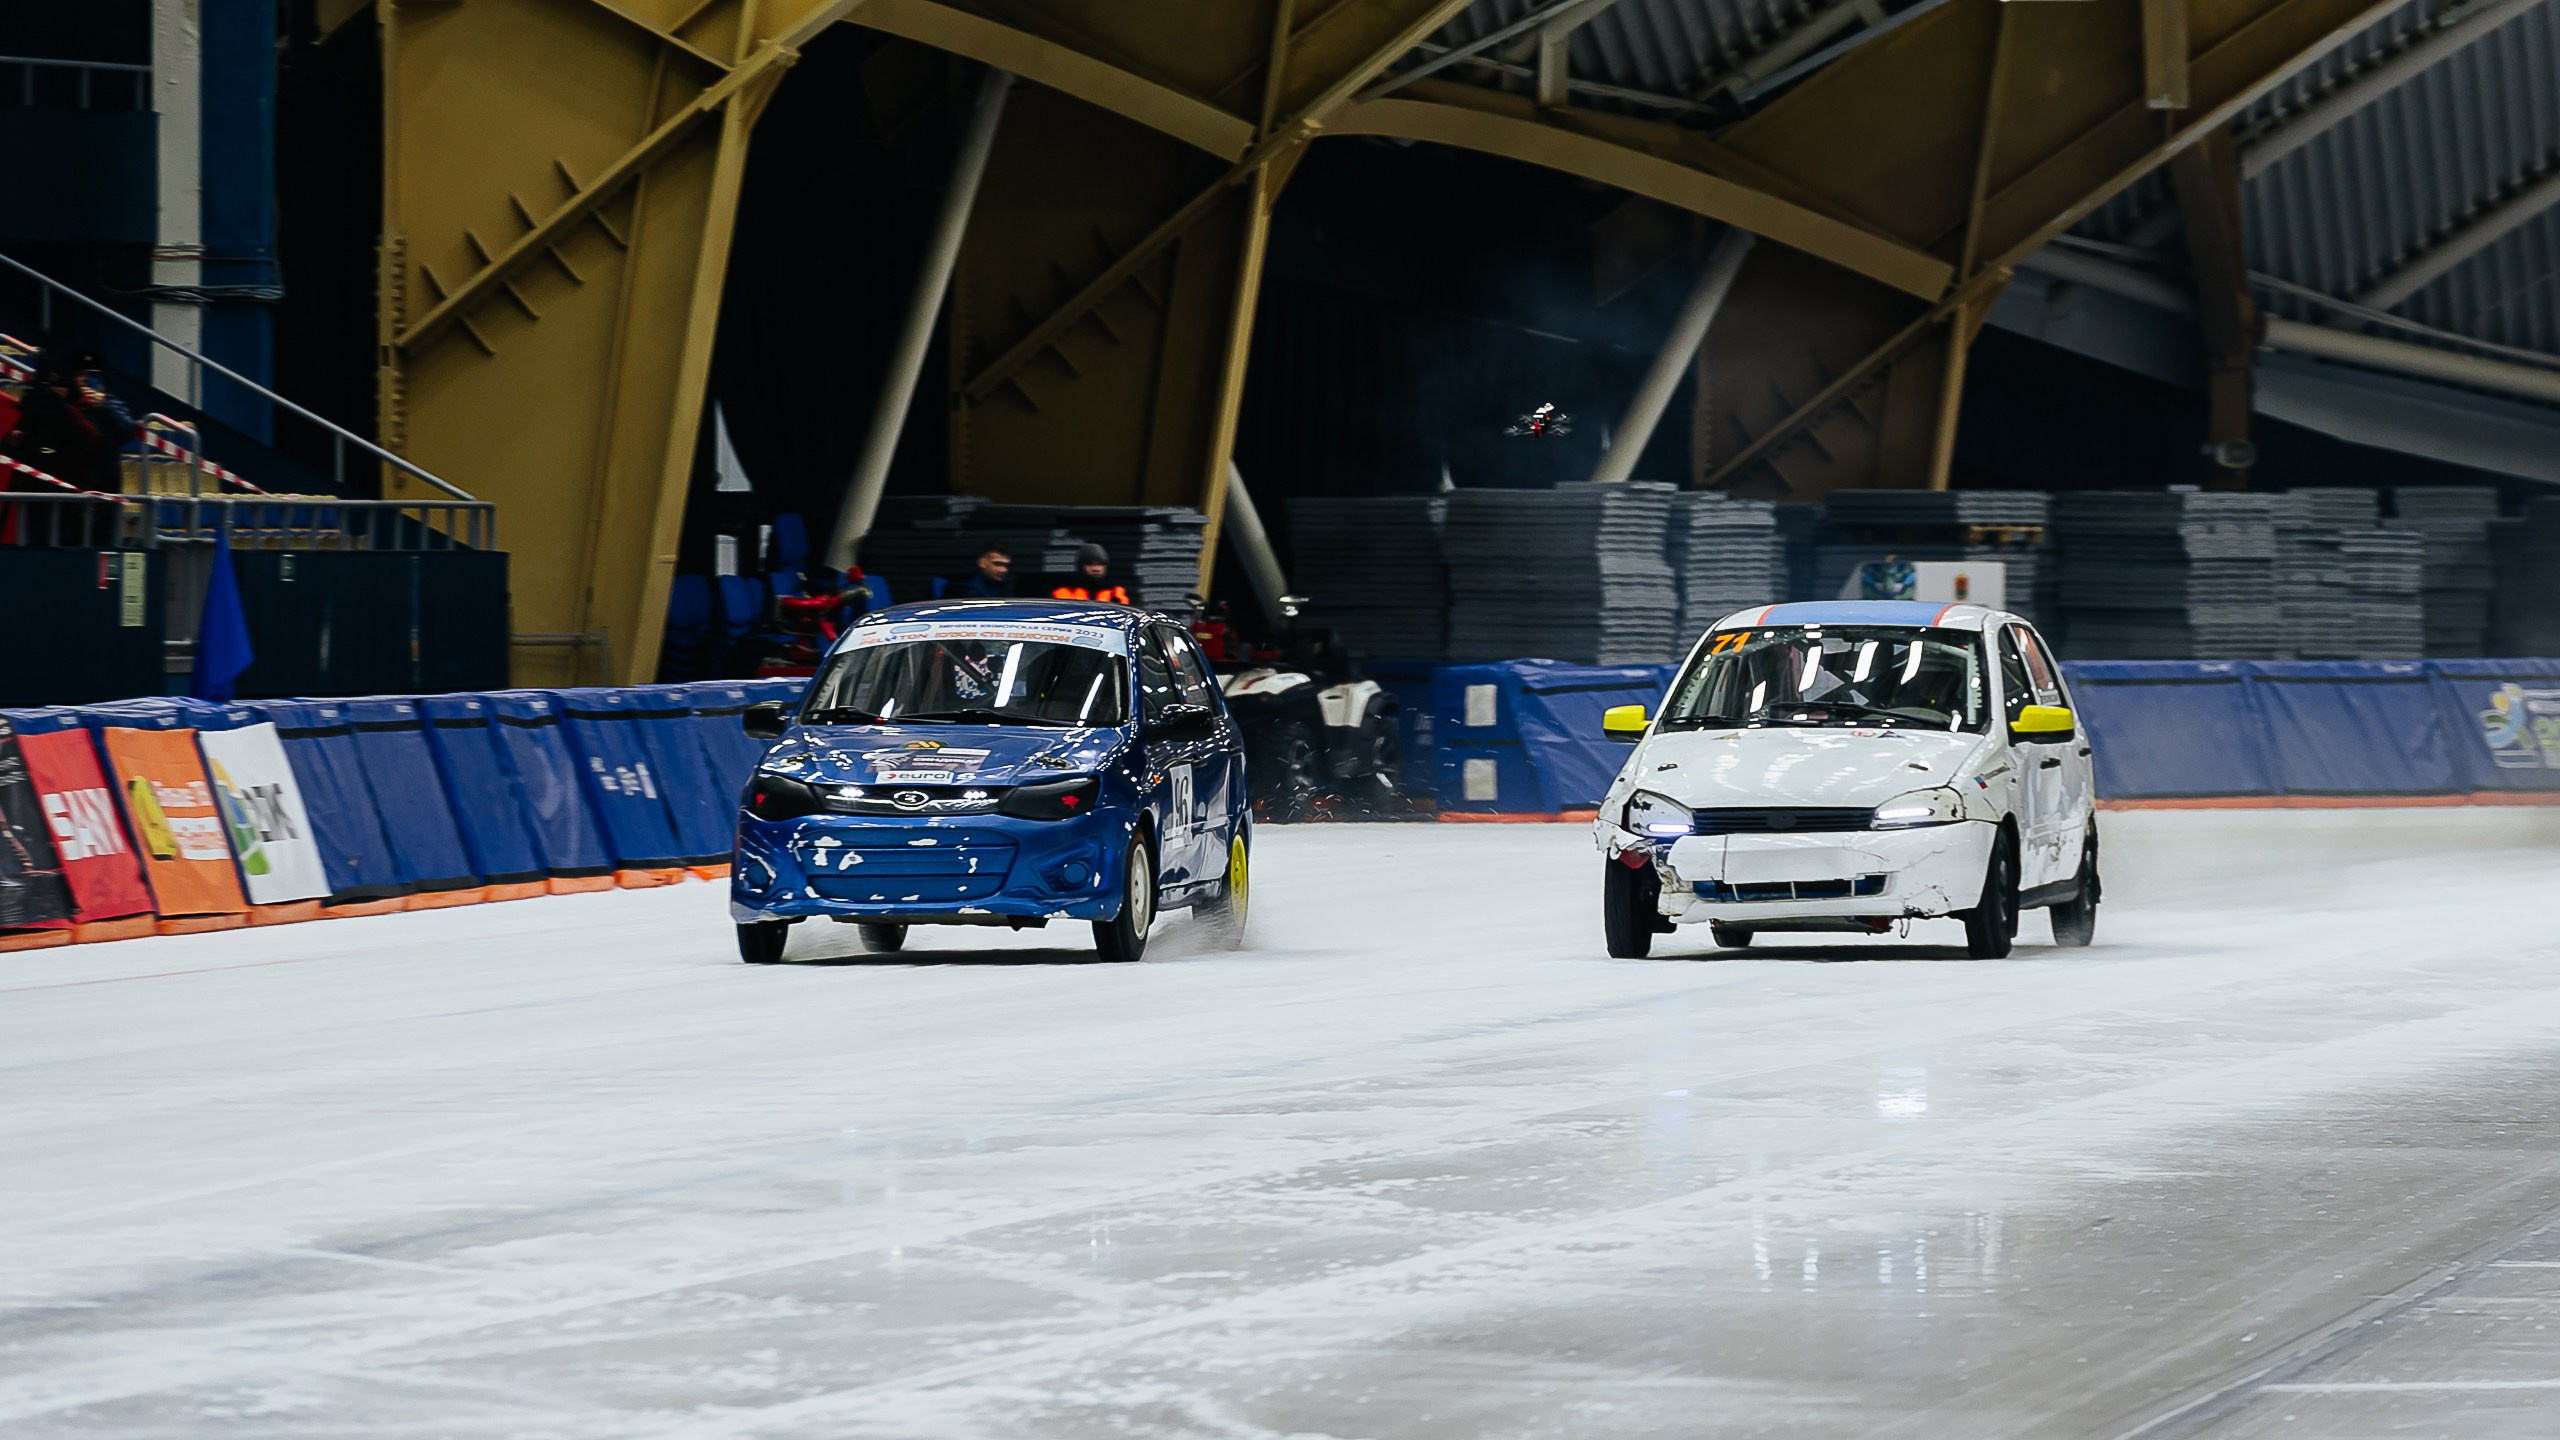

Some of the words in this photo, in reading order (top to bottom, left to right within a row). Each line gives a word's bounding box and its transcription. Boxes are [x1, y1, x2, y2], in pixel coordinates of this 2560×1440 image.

[1007, 631, 1071, 642] ПЕЛОТОН
[1076, 628, 1104, 639] 2023
[1711, 631, 1752, 655] 71
